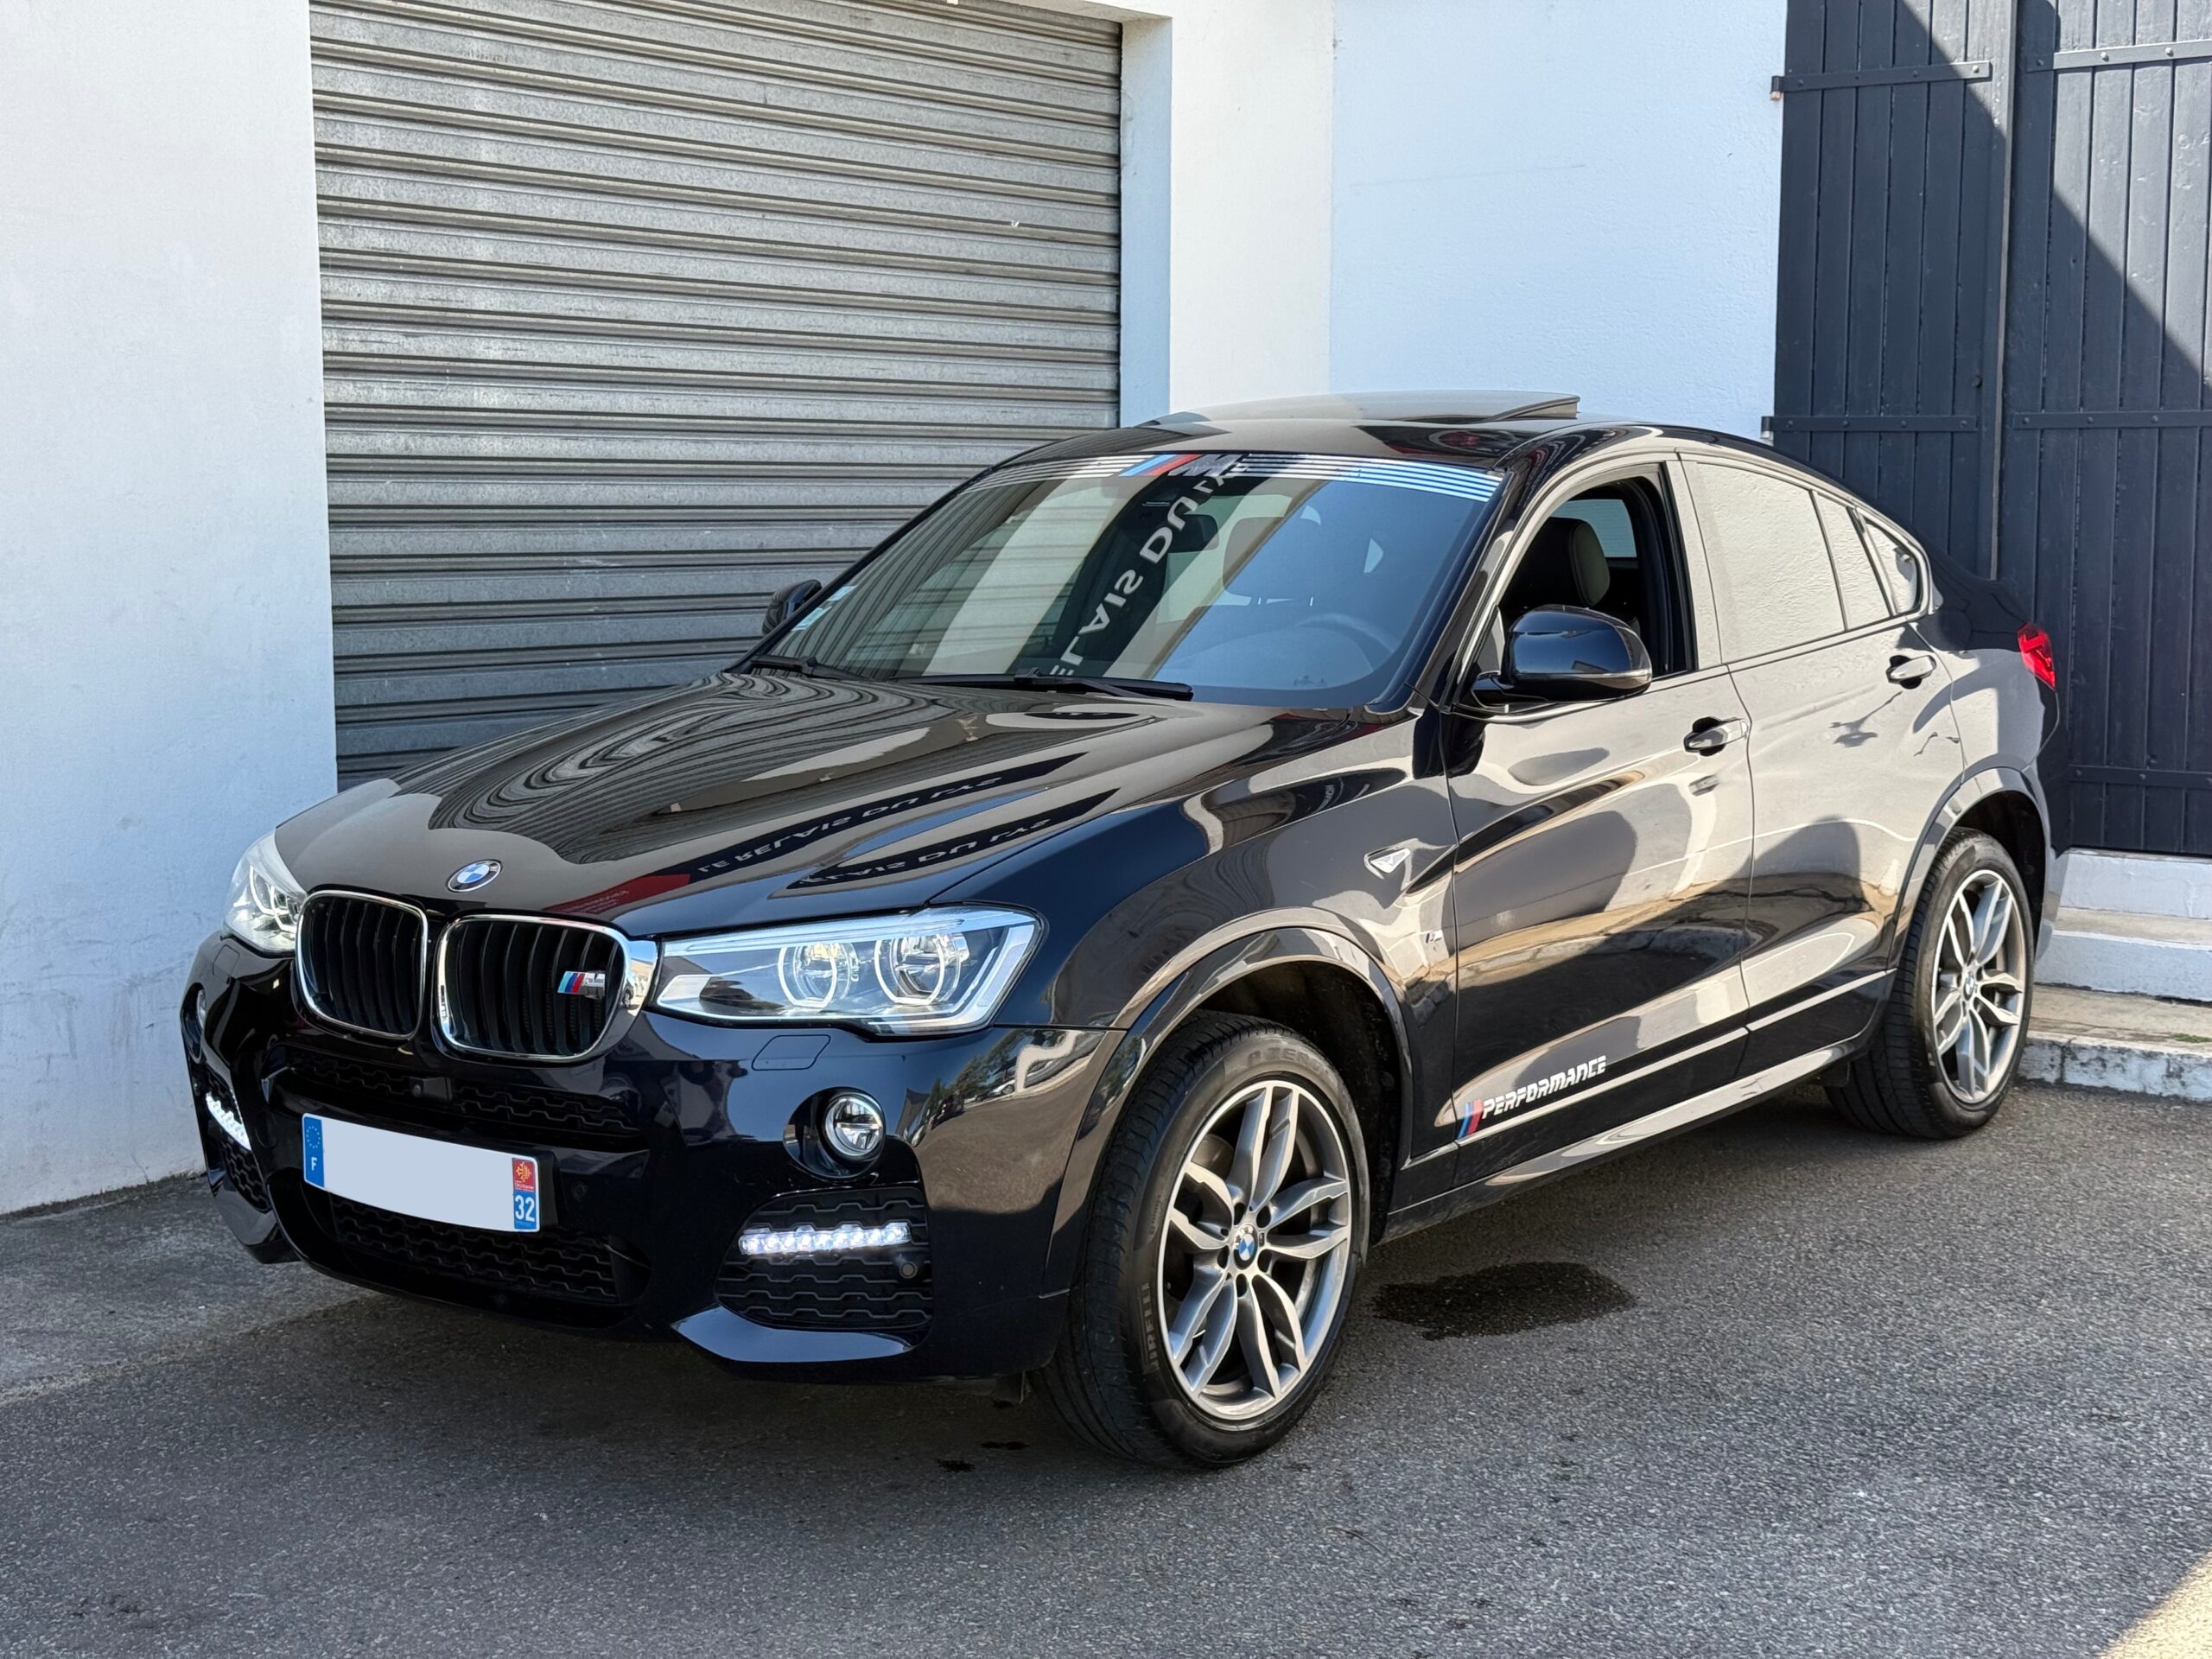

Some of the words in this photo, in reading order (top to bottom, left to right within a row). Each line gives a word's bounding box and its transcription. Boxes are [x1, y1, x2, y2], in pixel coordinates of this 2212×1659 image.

[1481, 1054, 1607, 1120] PERFORMANCE
[310, 1156, 318, 1171] F
[514, 1194, 536, 1223] 32
